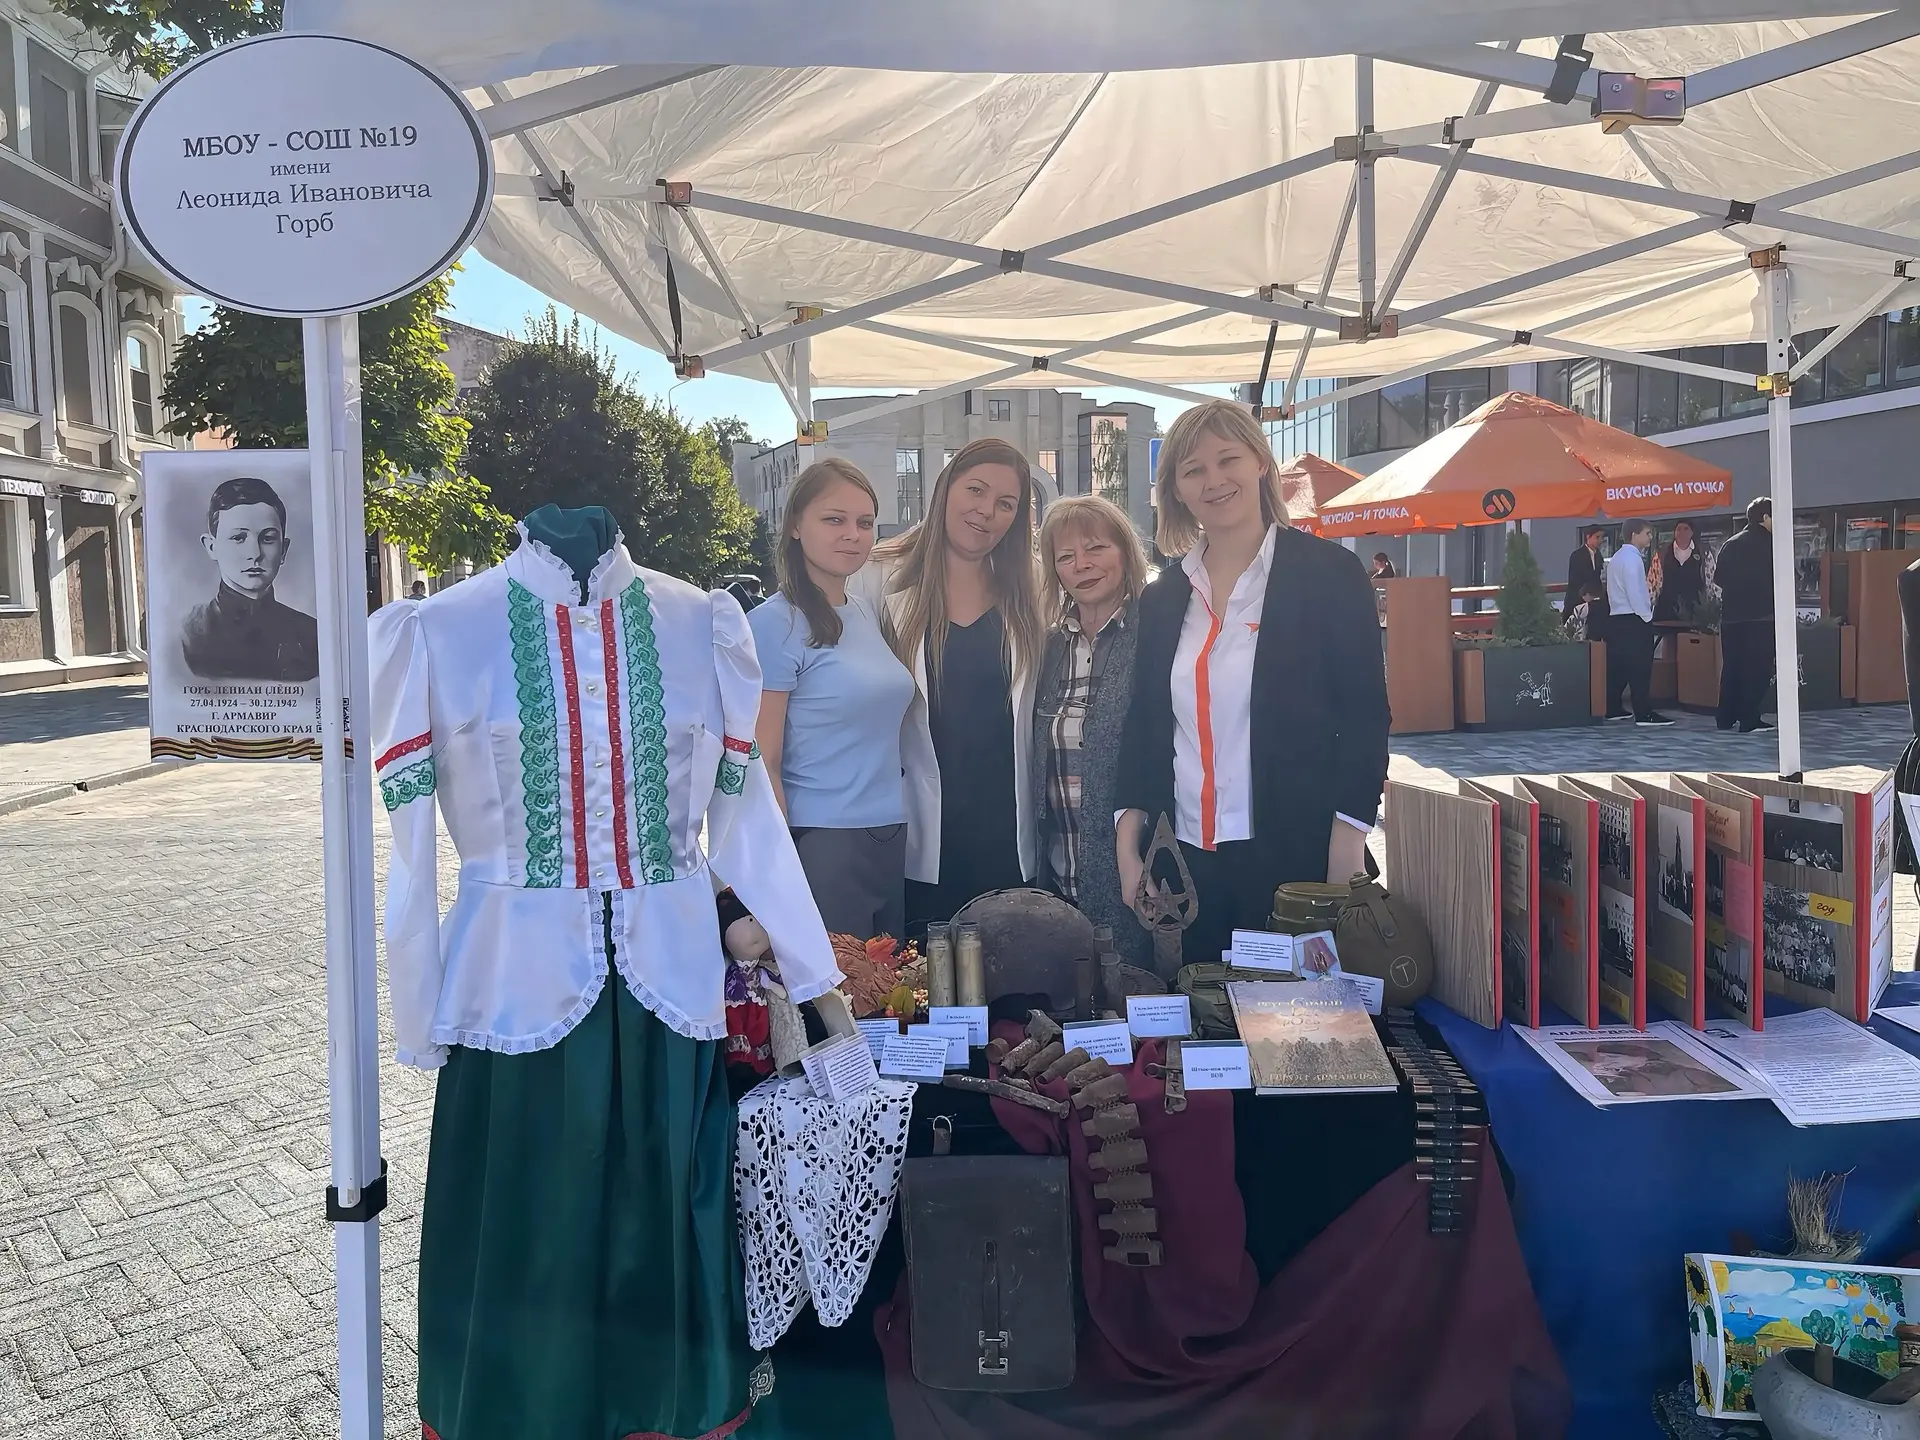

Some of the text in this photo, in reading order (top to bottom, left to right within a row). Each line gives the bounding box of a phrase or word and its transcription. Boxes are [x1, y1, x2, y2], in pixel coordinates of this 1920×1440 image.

[183, 133, 261, 158] МБОУ
[286, 128, 352, 152] СОШ
[359, 125, 418, 149] №19
[269, 162, 331, 177] имени
[176, 182, 433, 211] Леонида Ивановича
[276, 211, 334, 239] Горб
[1686, 481, 1725, 494] ТОЧКА
[1373, 506, 1409, 520] ТОЧКА
[183, 685, 211, 695] ГОРБ
[190, 698, 238, 708] 27.04.1924
[249, 698, 298, 708] 30.12.1942
[211, 711, 277, 721] Г. АРМАВИР
[176, 723, 313, 734] КРАСНОДАРСКОГО КРАЯ
